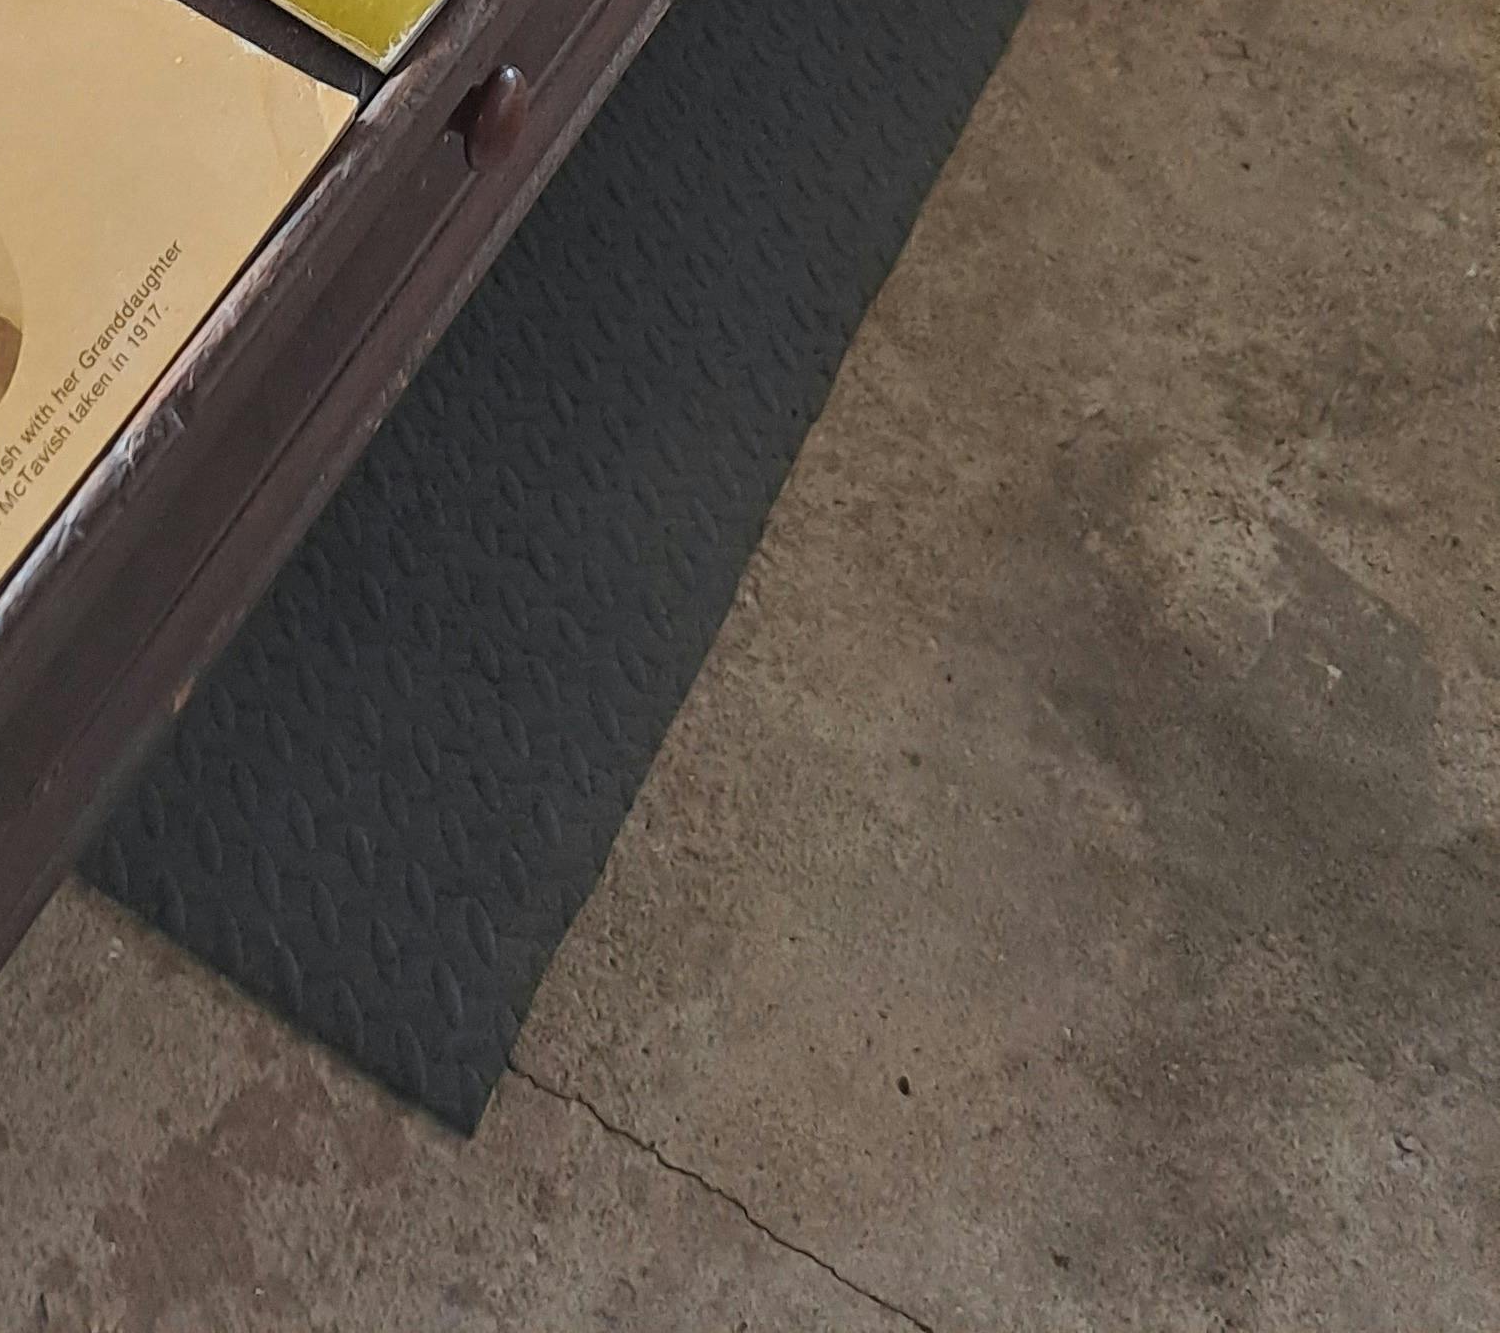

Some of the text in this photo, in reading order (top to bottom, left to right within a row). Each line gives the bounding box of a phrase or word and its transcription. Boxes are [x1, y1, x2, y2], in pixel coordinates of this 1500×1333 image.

[21, 400, 58, 445] with
[50, 368, 82, 406] her
[78, 237, 185, 372] Granddaughter
[69, 373, 116, 426] taken
[110, 349, 132, 376] in
[126, 304, 171, 353] 1917.
